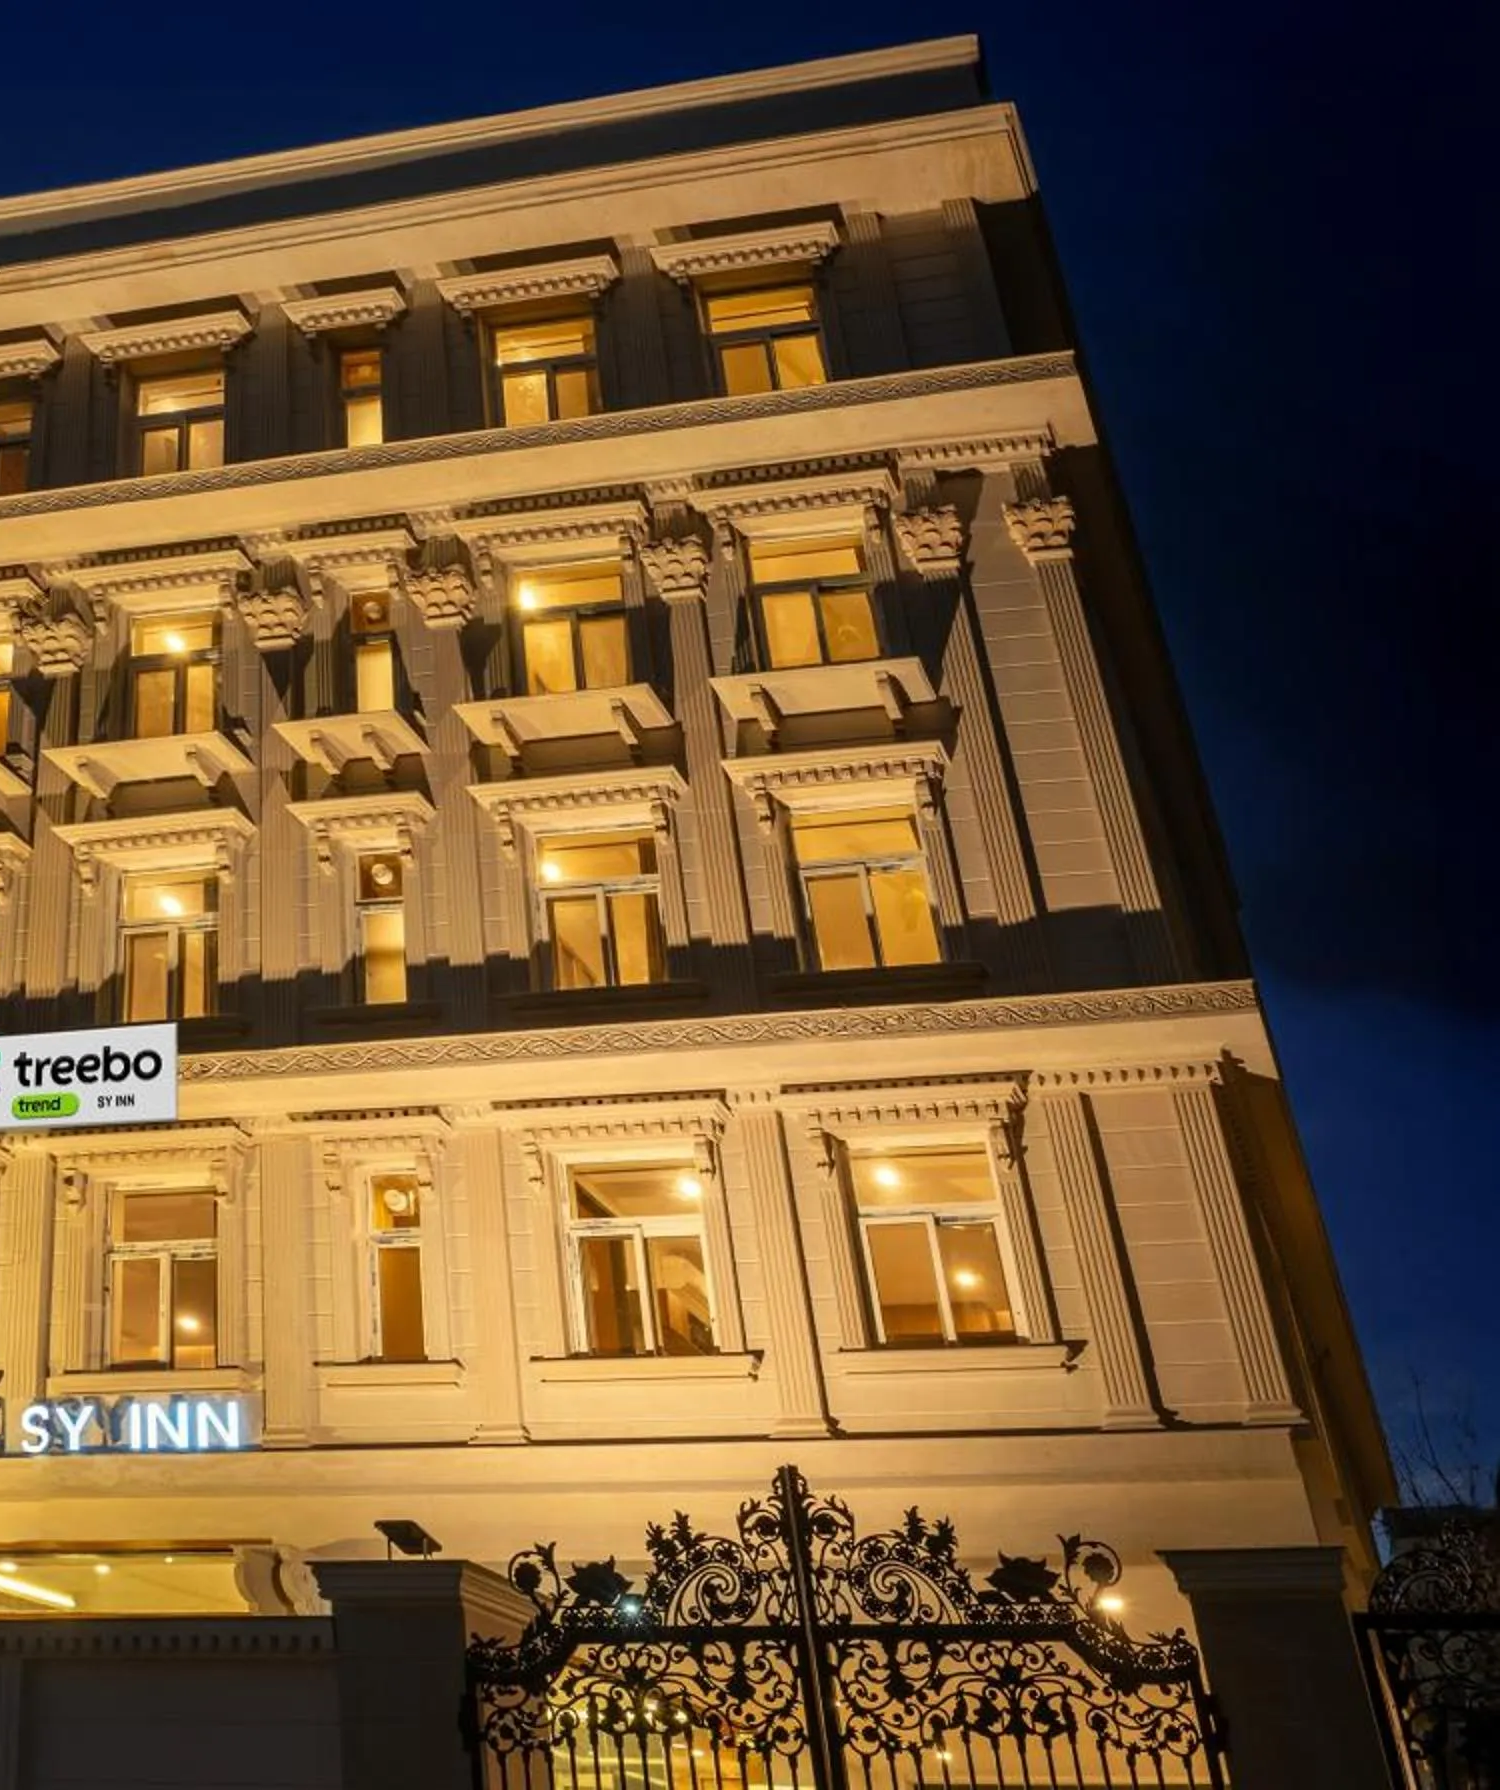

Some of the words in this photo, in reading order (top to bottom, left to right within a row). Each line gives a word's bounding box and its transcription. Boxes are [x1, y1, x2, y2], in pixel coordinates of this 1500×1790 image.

[14, 1046, 162, 1087] treebo
[17, 1096, 61, 1113] trend
[97, 1095, 113, 1108] SY
[115, 1094, 136, 1107] INN
[21, 1404, 95, 1453] SY
[129, 1401, 240, 1450] INN
